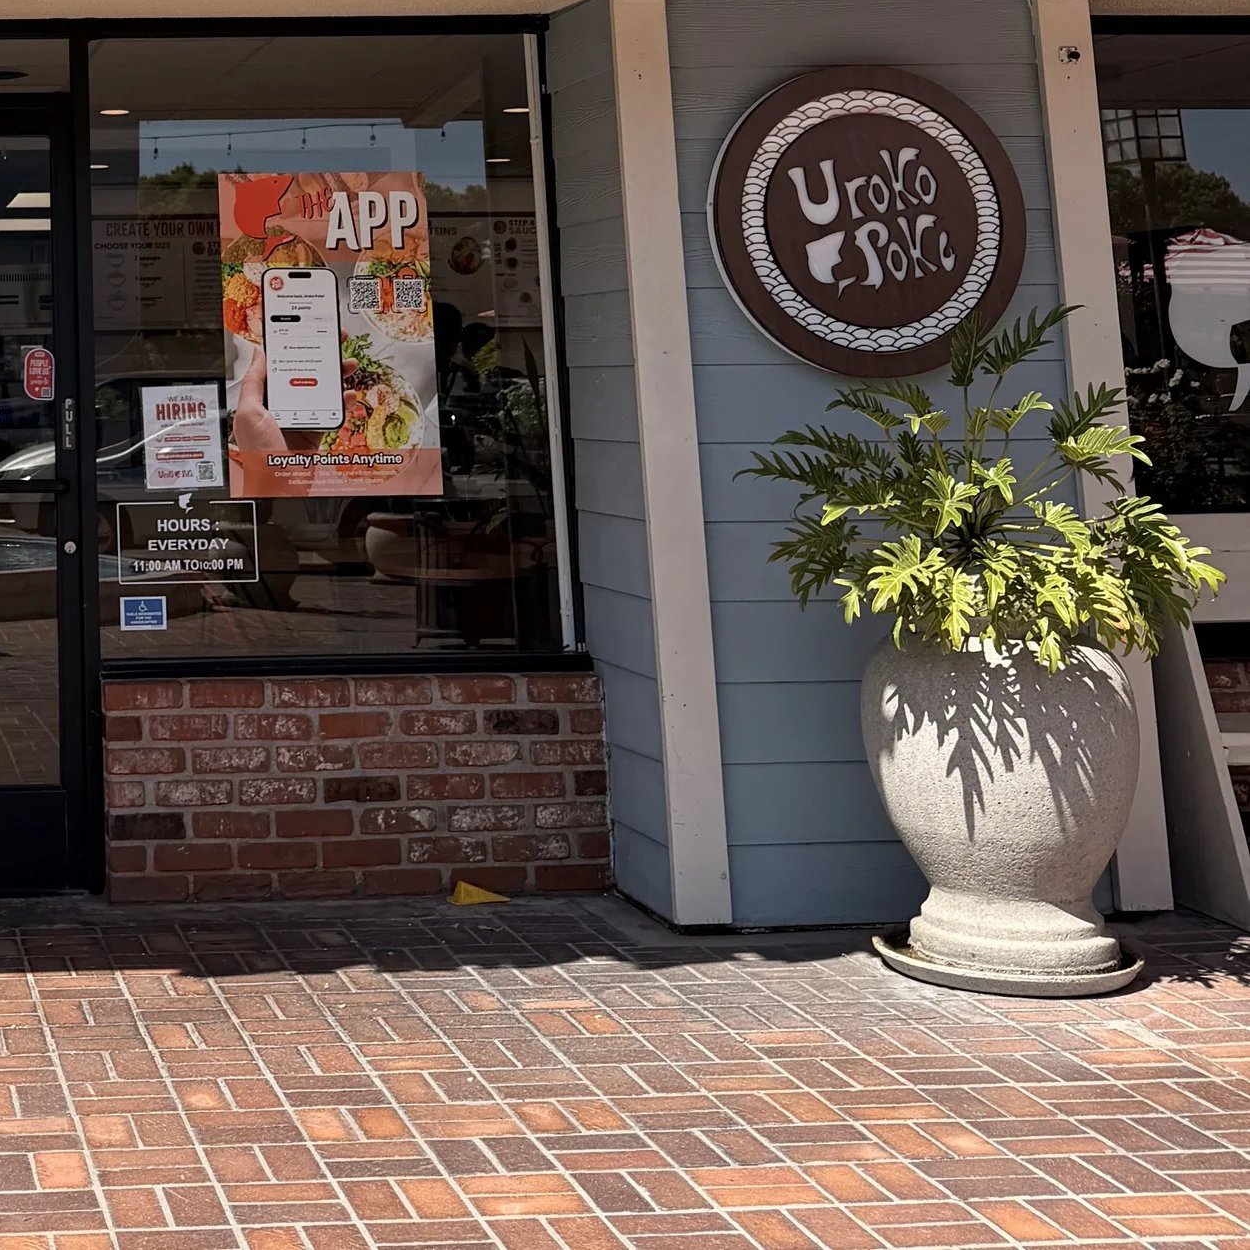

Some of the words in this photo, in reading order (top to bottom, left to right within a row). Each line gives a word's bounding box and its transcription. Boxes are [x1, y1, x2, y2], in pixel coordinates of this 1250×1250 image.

[106, 222, 151, 237] CREATE
[154, 221, 185, 236] YOUR
[188, 221, 214, 236] OWN
[325, 191, 420, 252] APP
[509, 226, 537, 235] SAUC
[94, 242, 128, 250] CHOOSE
[156, 402, 207, 421] HIRING
[64, 398, 74, 448] PULL
[268, 454, 311, 468] Loyalty
[313, 453, 350, 466] Points
[352, 452, 403, 467] Anytime
[157, 518, 211, 532] HOURS
[147, 538, 229, 551] EVERYDAY
[133, 560, 161, 572] 11:00
[163, 560, 181, 571] AM
[226, 558, 244, 570] PM
